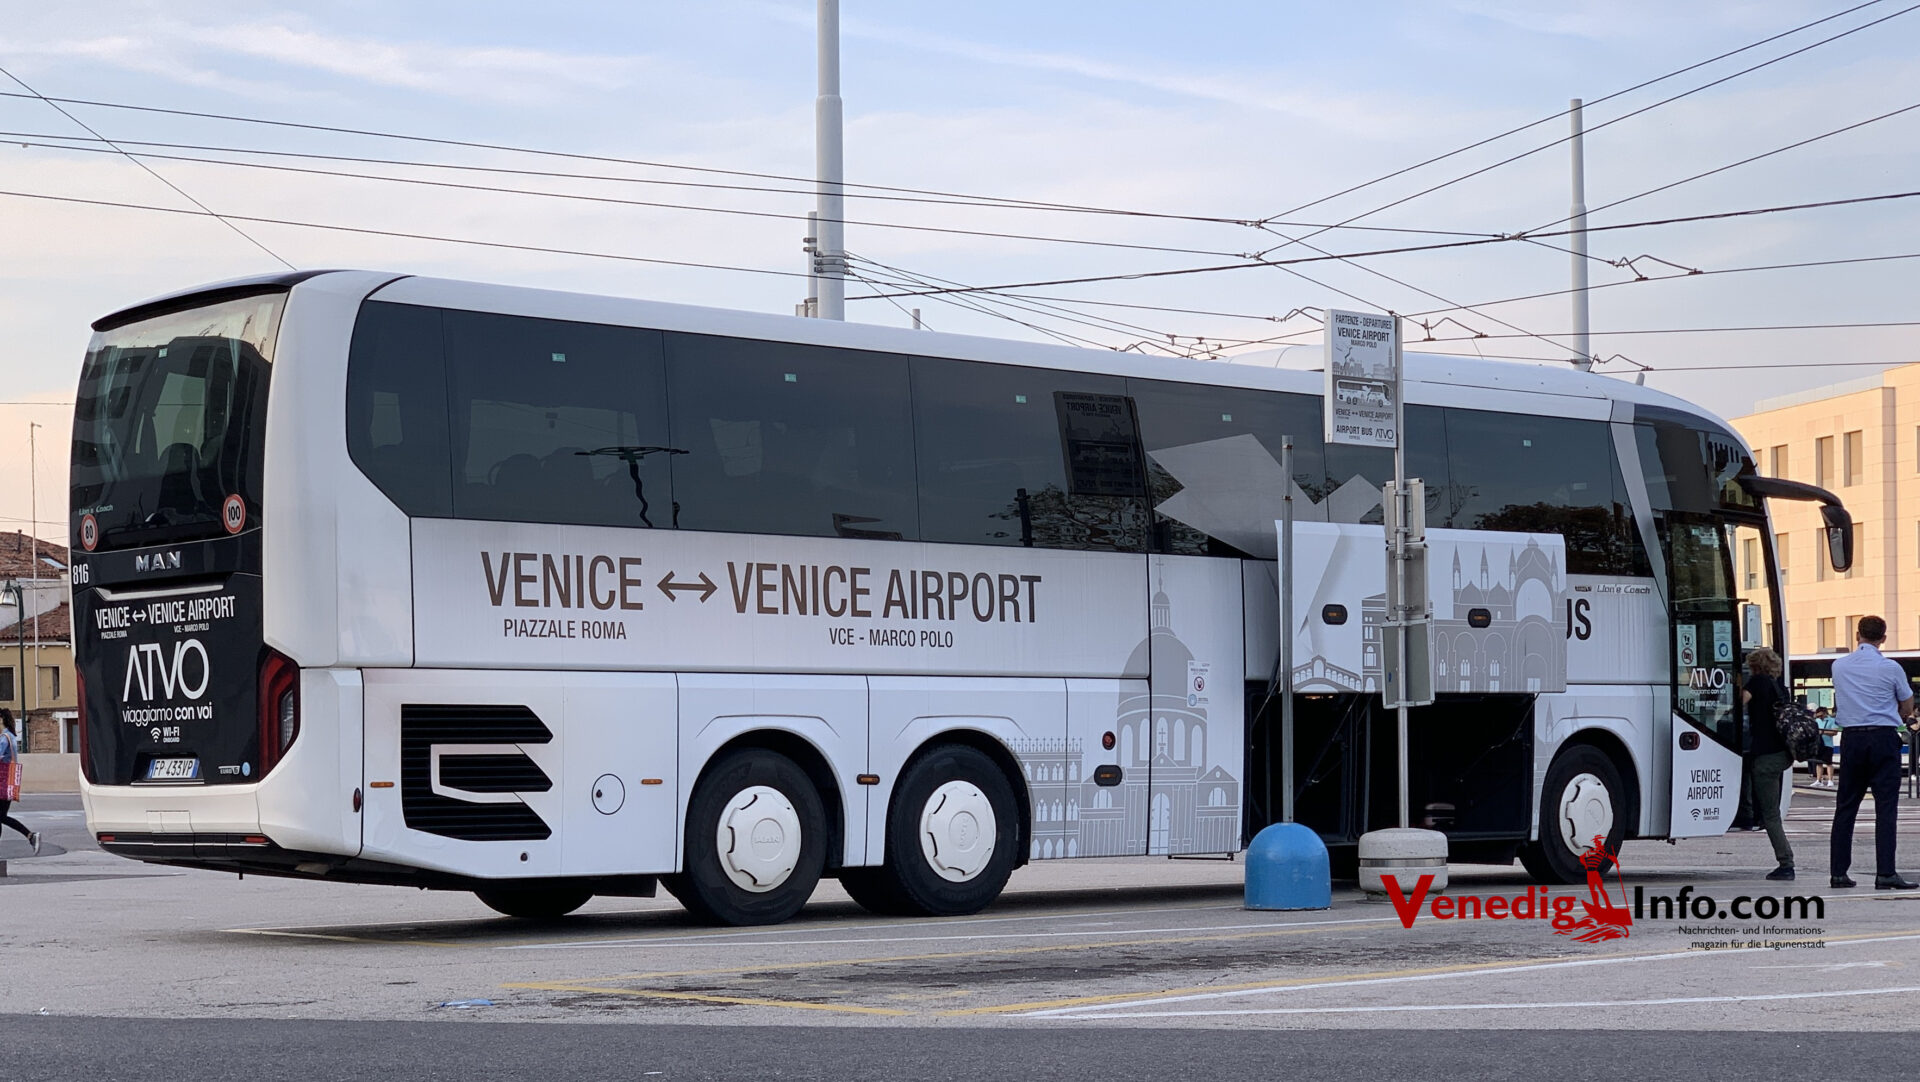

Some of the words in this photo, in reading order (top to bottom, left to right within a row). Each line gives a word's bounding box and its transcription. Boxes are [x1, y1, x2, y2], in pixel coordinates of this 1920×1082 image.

[1335, 314, 1359, 326] PARTENZE
[1362, 317, 1392, 330] DEPARTURES
[1337, 327, 1361, 339] VENICE
[1361, 330, 1390, 342] AIRPORT
[1350, 339, 1365, 347] MARCO
[1366, 340, 1377, 349] POLO
[1336, 424, 1360, 435] AIRPORT
[1361, 427, 1373, 436] BUS
[227, 505, 241, 521] 100
[84, 525, 94, 540] 80
[135, 551, 181, 573] MAN
[72, 563, 89, 585] 816
[480, 551, 644, 611] VENICE
[727, 561, 872, 618] VENICE
[881, 569, 1042, 623] AIRPORT
[1623, 585, 1651, 595] Coach
[95, 606, 131, 630] VENICE
[147, 601, 186, 625] VENICE
[187, 595, 236, 621] AIRPORT
[503, 618, 576, 639] PIAZZALE
[581, 620, 627, 640] ROMA
[829, 627, 855, 646] VCE
[869, 628, 916, 648] MARCO
[920, 630, 954, 649] POLO
[122, 638, 210, 703] ATVO
[1689, 667, 1726, 689] ATVO
[1679, 698, 1695, 713] 816
[122, 705, 173, 727] viaggiamo
[174, 706, 195, 721] con
[197, 701, 213, 720] voi
[162, 726, 180, 737] WI-FI
[1690, 769, 1721, 783] VENICE
[1687, 785, 1724, 800] AIRPORT
[1703, 807, 1720, 815] WI-FI
